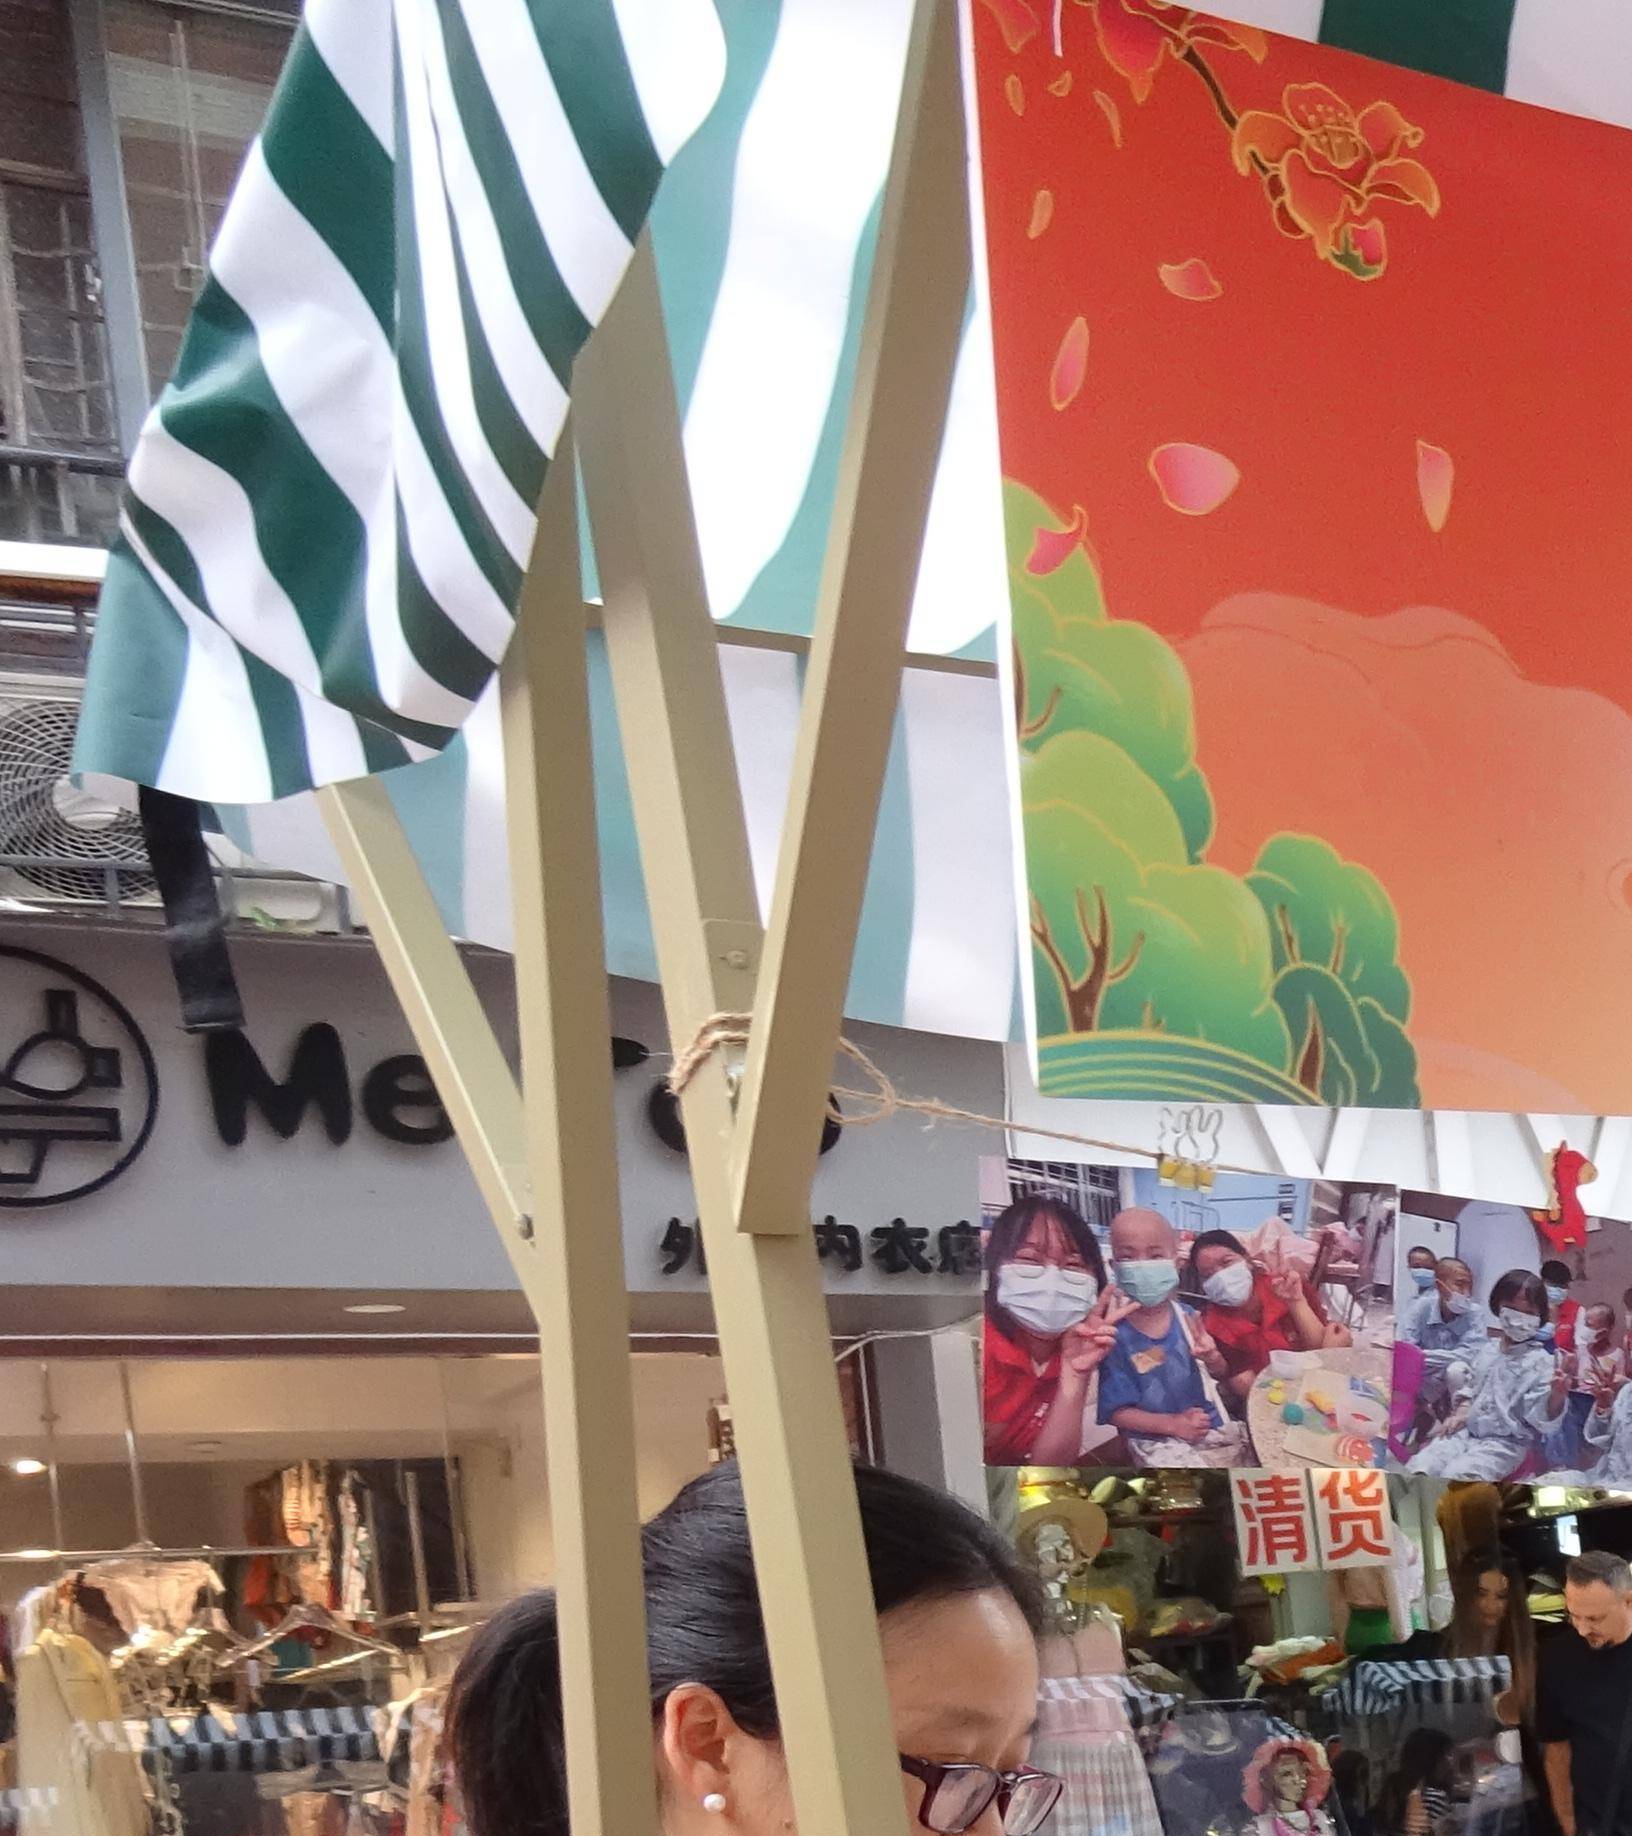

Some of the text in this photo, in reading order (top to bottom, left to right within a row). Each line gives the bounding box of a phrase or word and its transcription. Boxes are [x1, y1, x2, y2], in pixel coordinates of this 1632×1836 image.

[659, 1215, 982, 1275] 外内衣店
[1236, 1470, 1392, 1567] 清货
